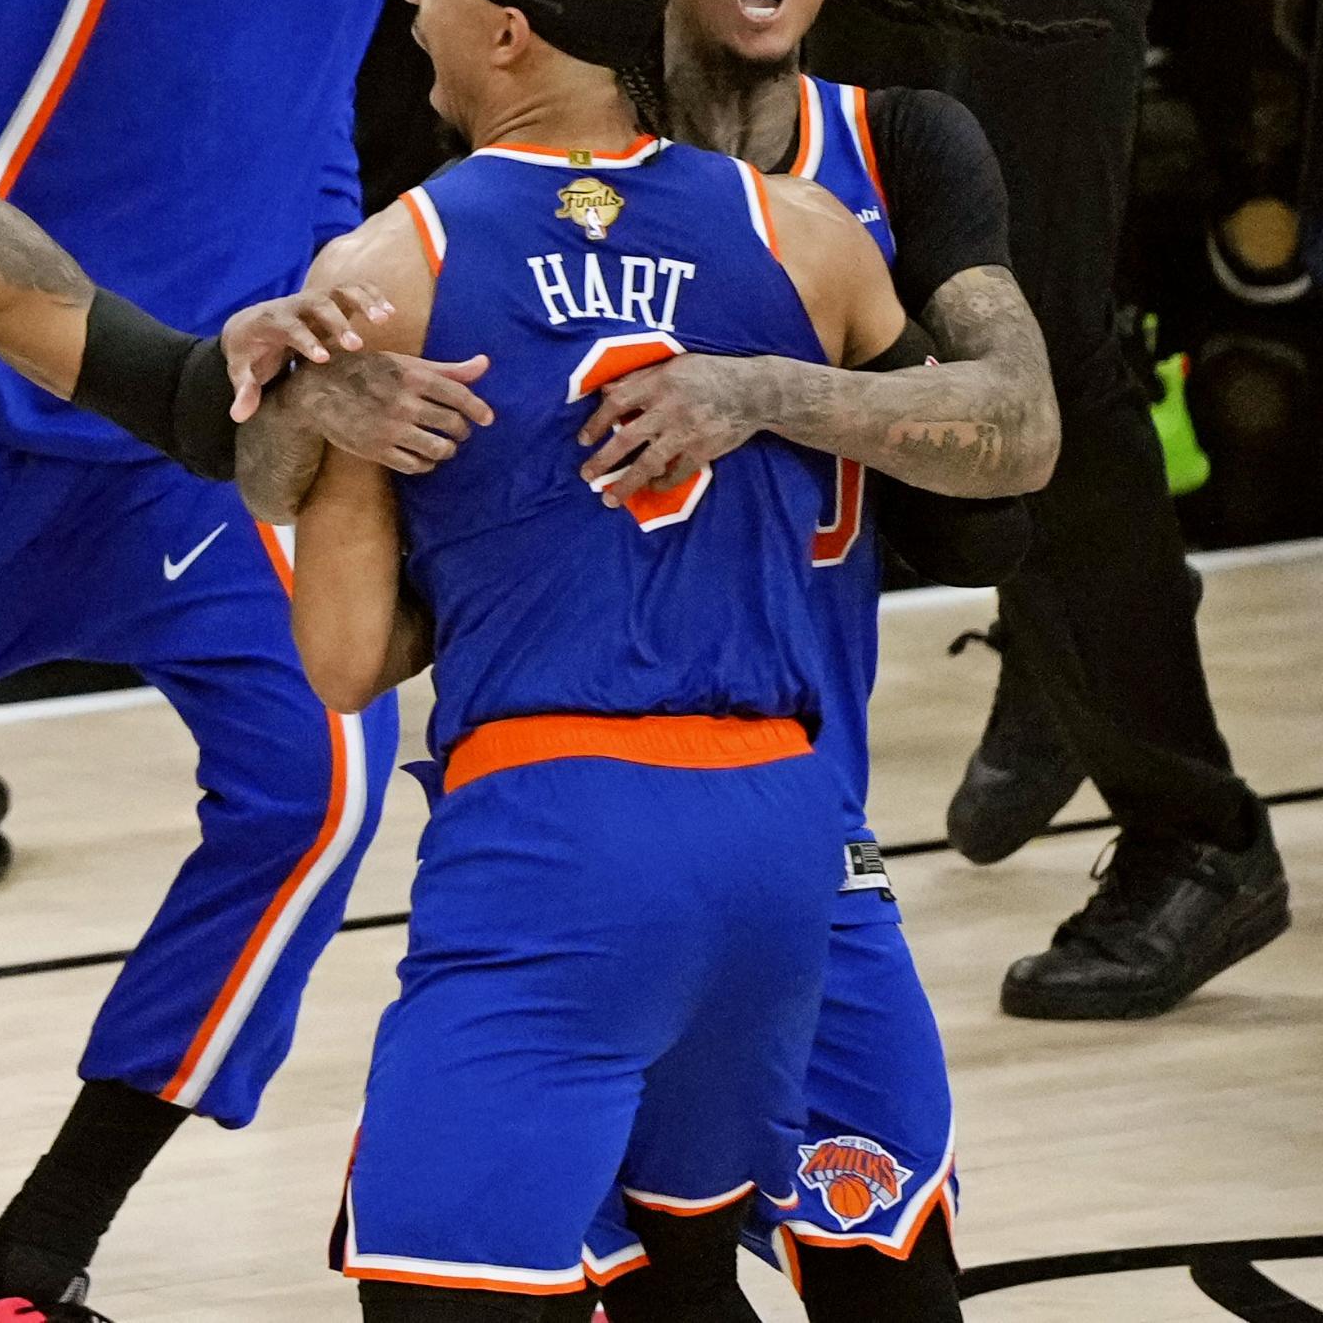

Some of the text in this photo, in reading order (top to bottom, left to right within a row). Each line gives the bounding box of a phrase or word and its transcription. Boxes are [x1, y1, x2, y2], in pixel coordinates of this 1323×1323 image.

[556, 187, 621, 216] Finals
[527, 252, 696, 333] HART
[801, 1141, 898, 1199] KNICKS
